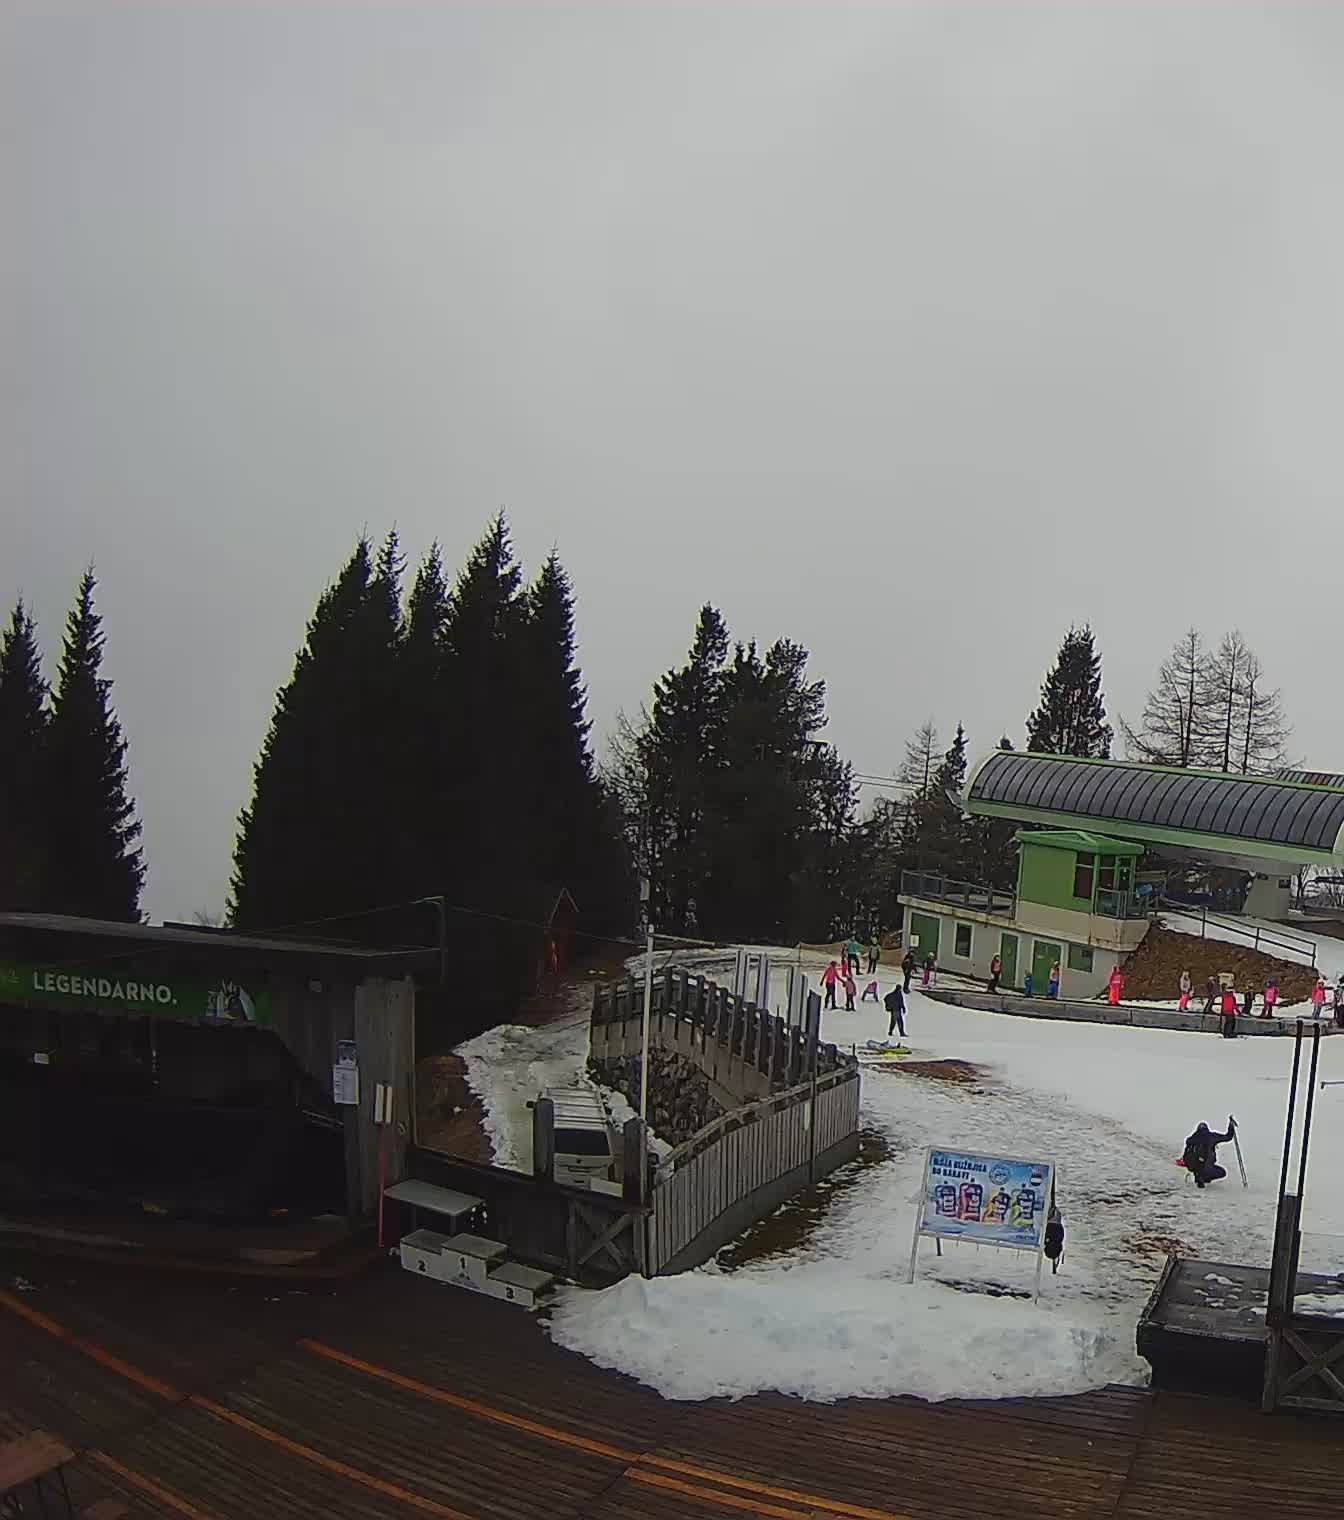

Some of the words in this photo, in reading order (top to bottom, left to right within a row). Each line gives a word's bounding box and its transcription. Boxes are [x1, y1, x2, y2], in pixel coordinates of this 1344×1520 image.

[32, 970, 179, 1005] LEGENDARNO.
[417, 1260, 427, 1272] 2
[505, 1286, 515, 1300] 3
